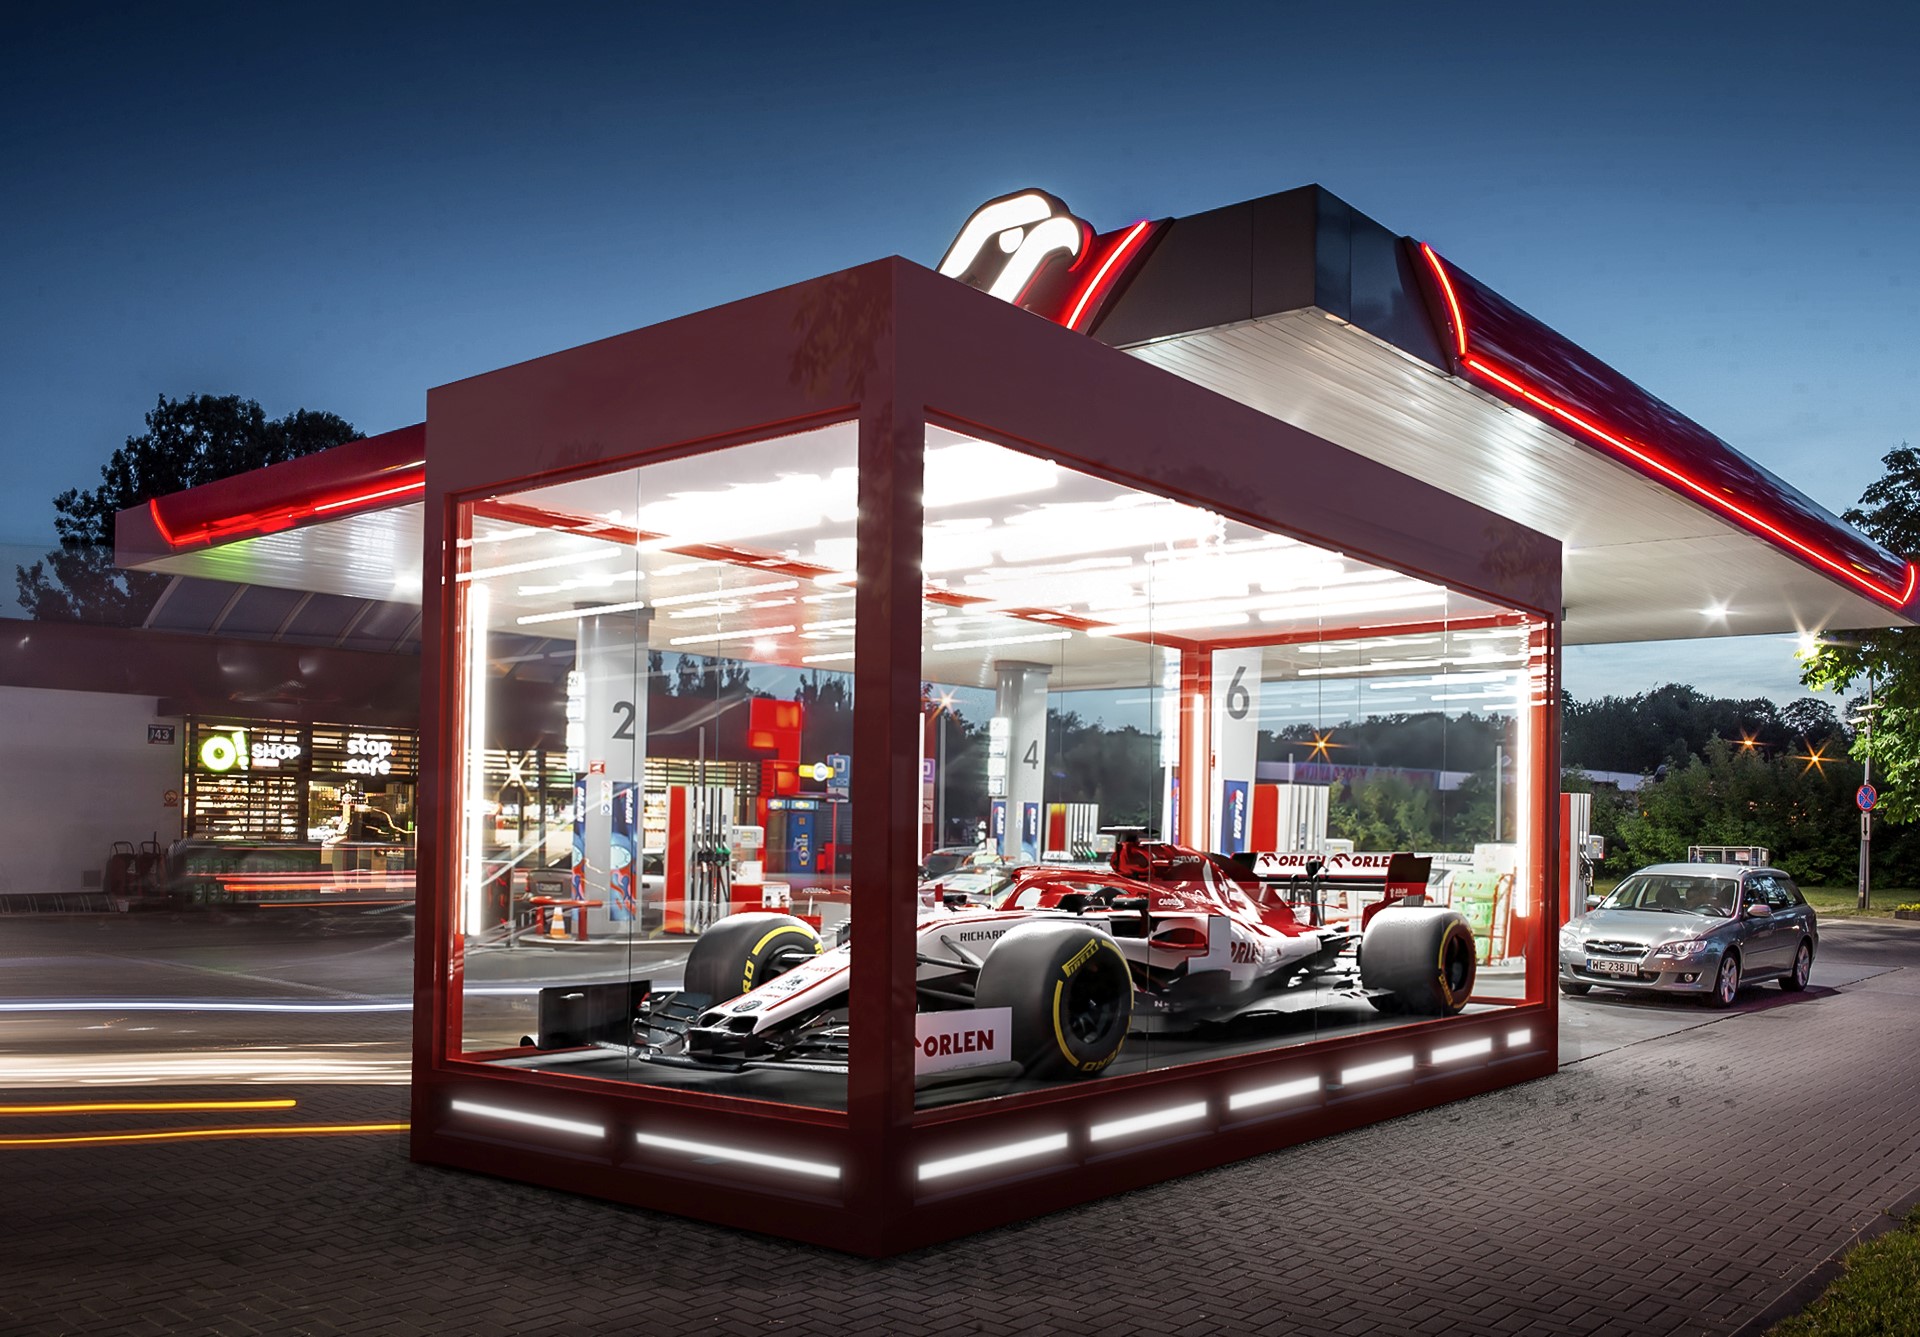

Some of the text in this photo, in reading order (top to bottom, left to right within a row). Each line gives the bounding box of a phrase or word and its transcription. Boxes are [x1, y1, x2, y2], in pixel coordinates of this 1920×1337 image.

[1226, 666, 1250, 720] 6
[611, 700, 636, 740] 2
[251, 743, 301, 760] SHOP
[1023, 740, 1039, 770] 4
[346, 757, 391, 776] cafe
[1352, 855, 1390, 867] ORLE
[1062, 938, 1099, 978] PIRELLI
[1592, 960, 1636, 973] WE 238JU
[923, 1029, 994, 1057] ORLEN
